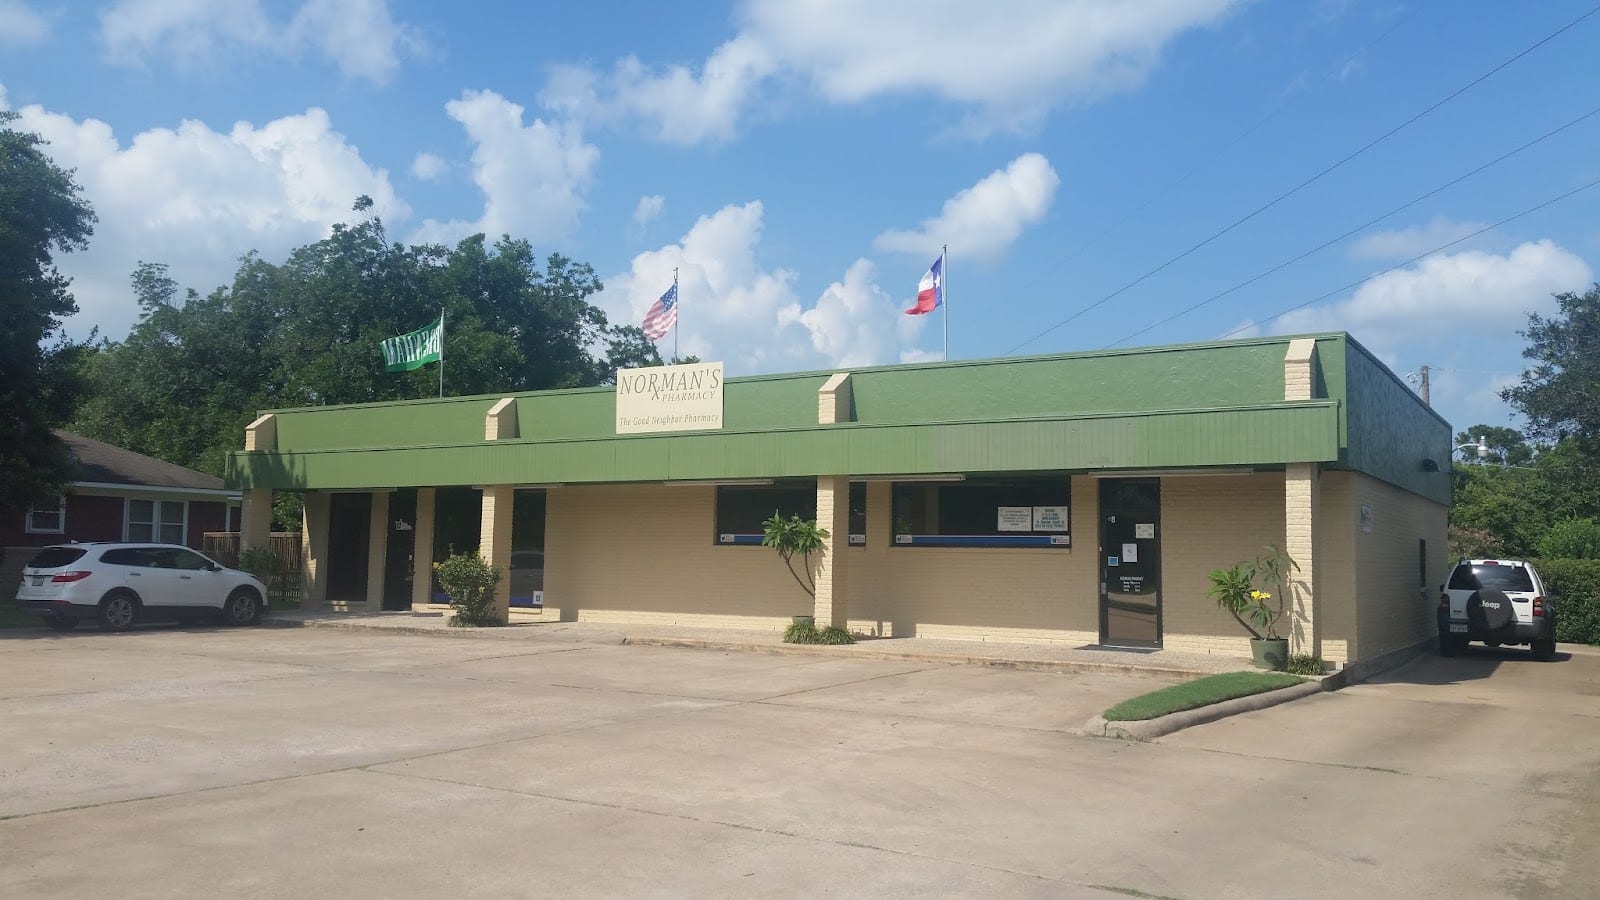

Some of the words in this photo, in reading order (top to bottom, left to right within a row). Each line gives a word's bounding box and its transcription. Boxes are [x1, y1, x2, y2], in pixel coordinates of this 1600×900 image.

[620, 369, 721, 400] NORMAN'S
[662, 391, 716, 402] PHARMACY
[620, 417, 631, 427] The
[633, 416, 650, 426] Good
[652, 415, 682, 426] Neighbor
[684, 414, 720, 424] Pharmacy
[1482, 600, 1500, 610] Jeep
